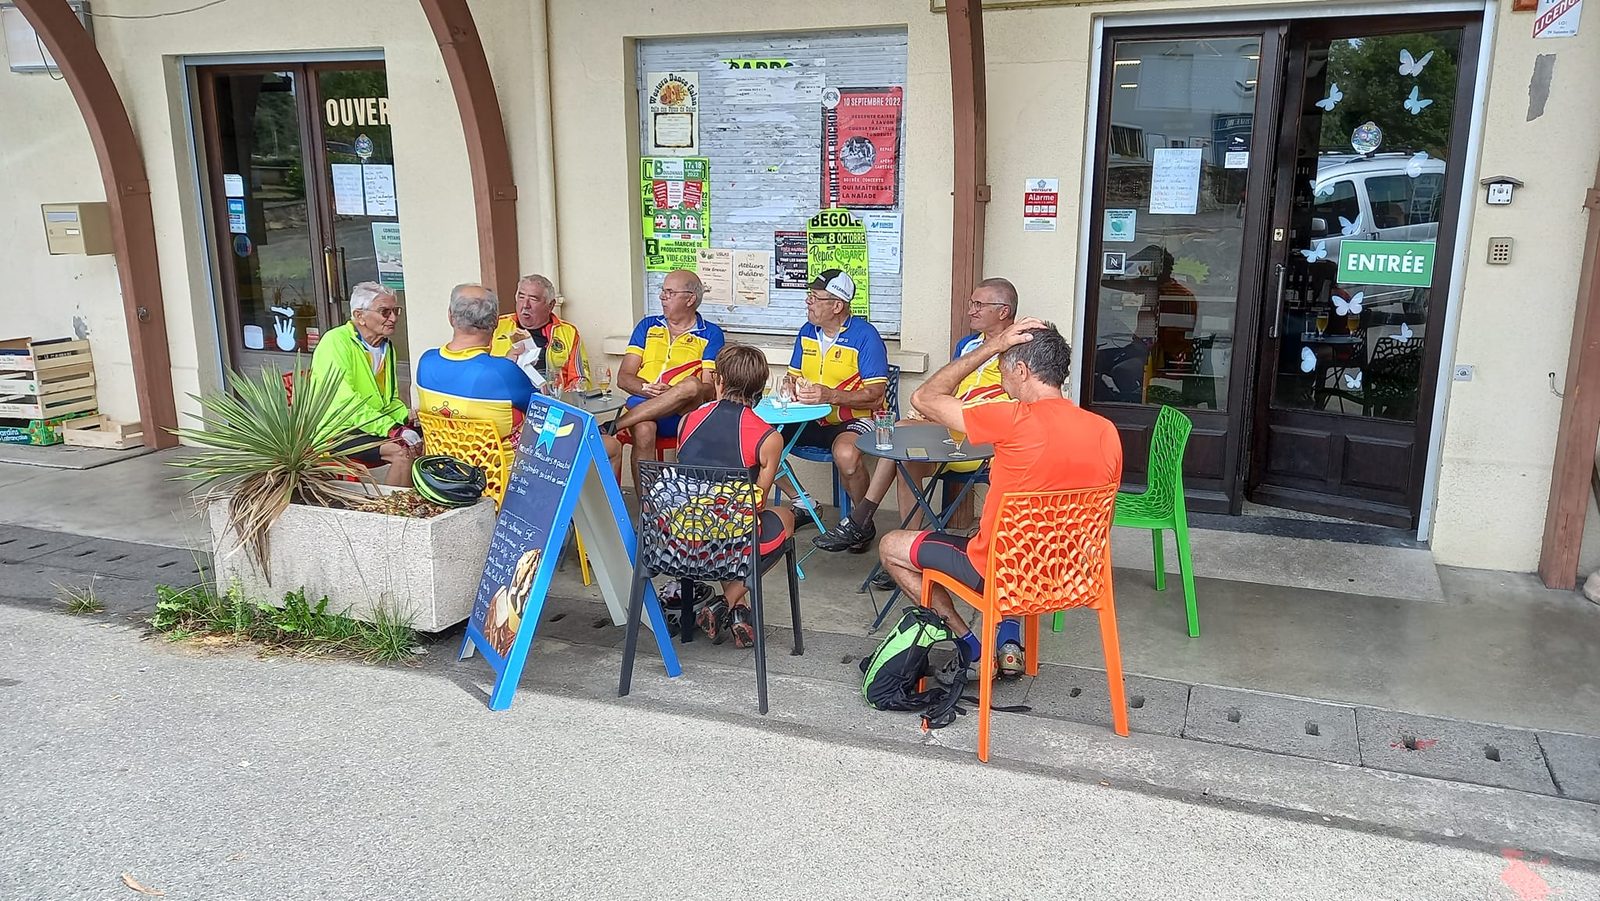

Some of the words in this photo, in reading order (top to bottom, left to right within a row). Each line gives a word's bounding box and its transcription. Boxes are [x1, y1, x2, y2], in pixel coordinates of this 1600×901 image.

[1535, 0, 1579, 34] LICENC
[649, 77, 669, 105] Western
[668, 73, 688, 87] Dance
[843, 97, 850, 106] 10
[851, 97, 884, 106] SEPTEMBRE
[885, 97, 901, 106] 2022
[684, 161, 692, 169] 17
[1028, 193, 1055, 201] Alarme
[809, 233, 828, 244] Samedi
[828, 232, 836, 244] 8
[837, 233, 866, 244] OCTOBRE
[649, 245, 655, 255] 4
[809, 245, 833, 262] Repas
[738, 262, 765, 270] Ateliers
[1347, 249, 1425, 273] ENTRÉE
